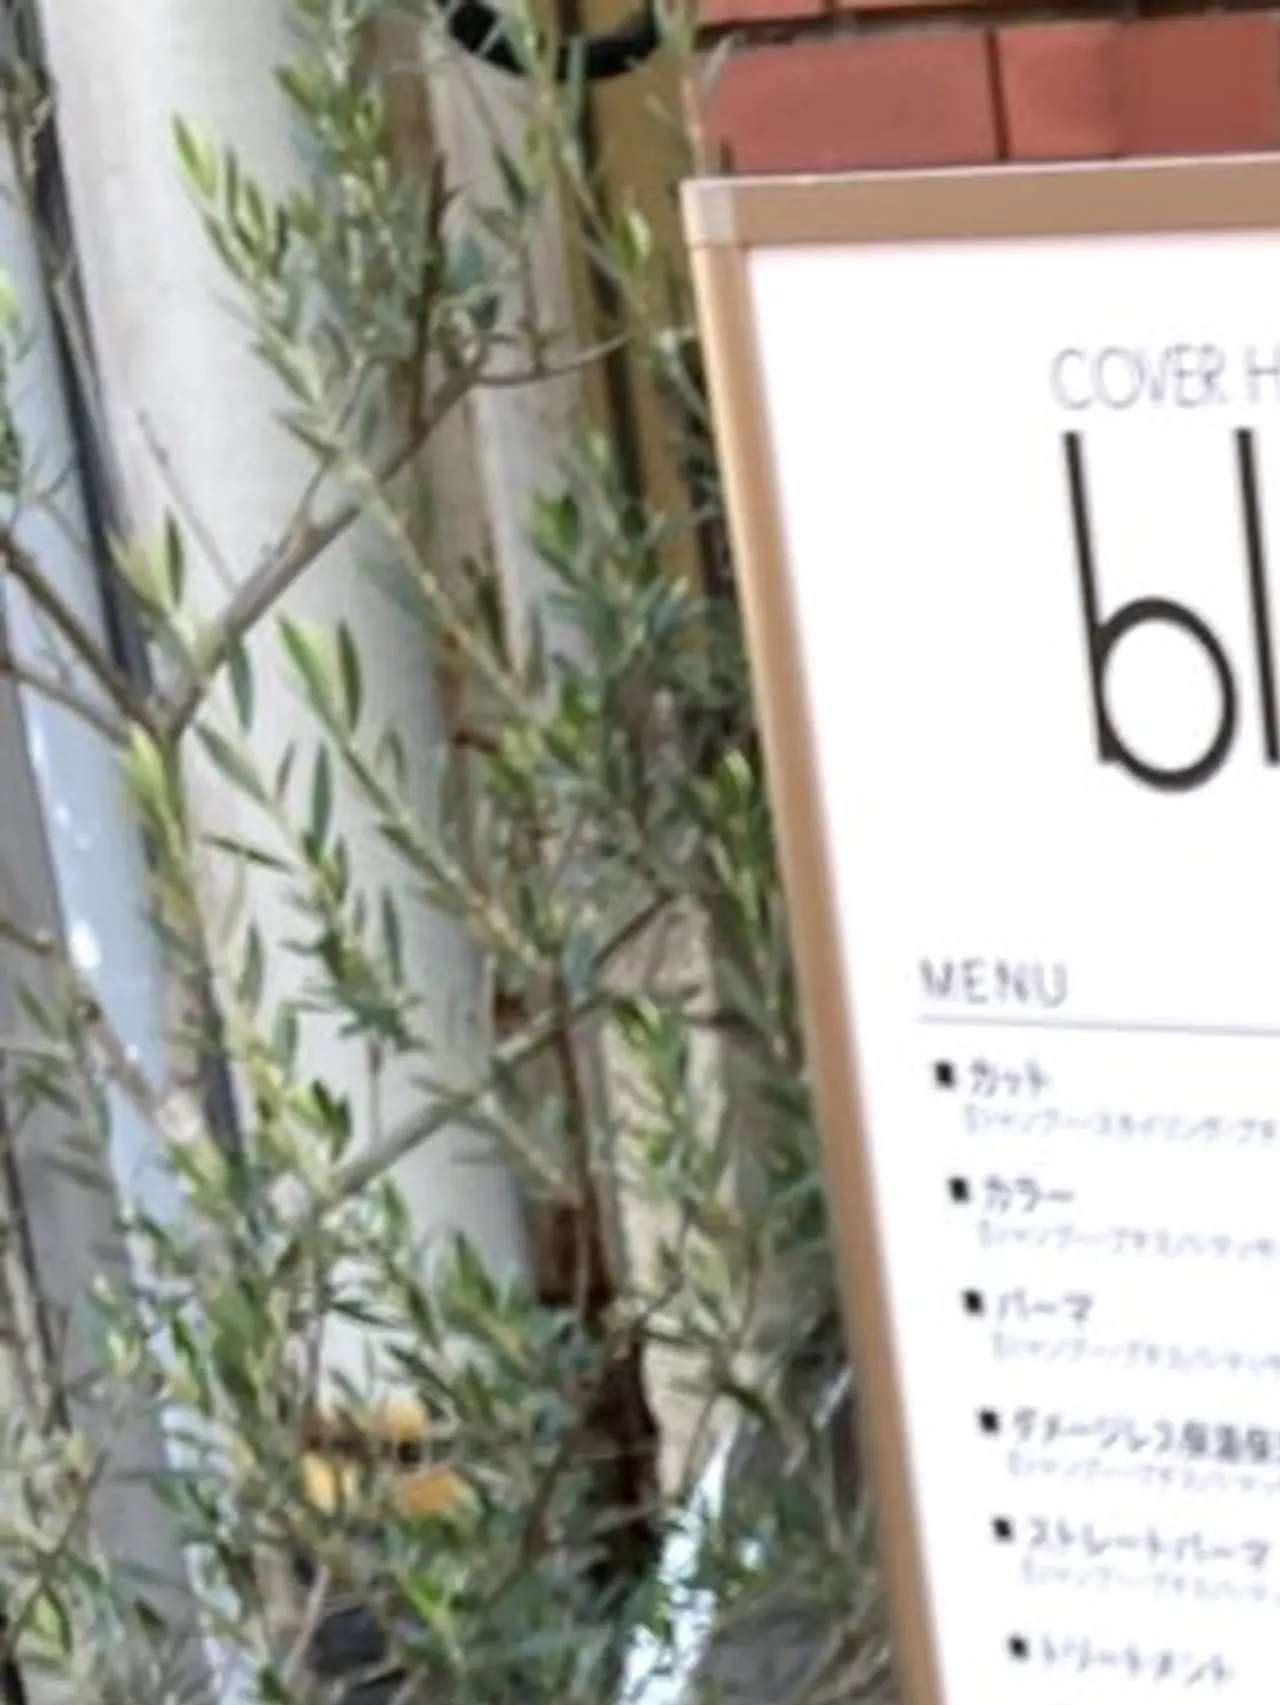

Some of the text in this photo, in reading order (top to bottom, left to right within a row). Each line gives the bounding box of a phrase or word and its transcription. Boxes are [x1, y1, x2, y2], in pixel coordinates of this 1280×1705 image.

[1050, 343, 1230, 411] COVER
[919, 957, 1070, 1008] MENU
[984, 1174, 1076, 1213] カラー
[999, 1288, 1095, 1323] パーマ
